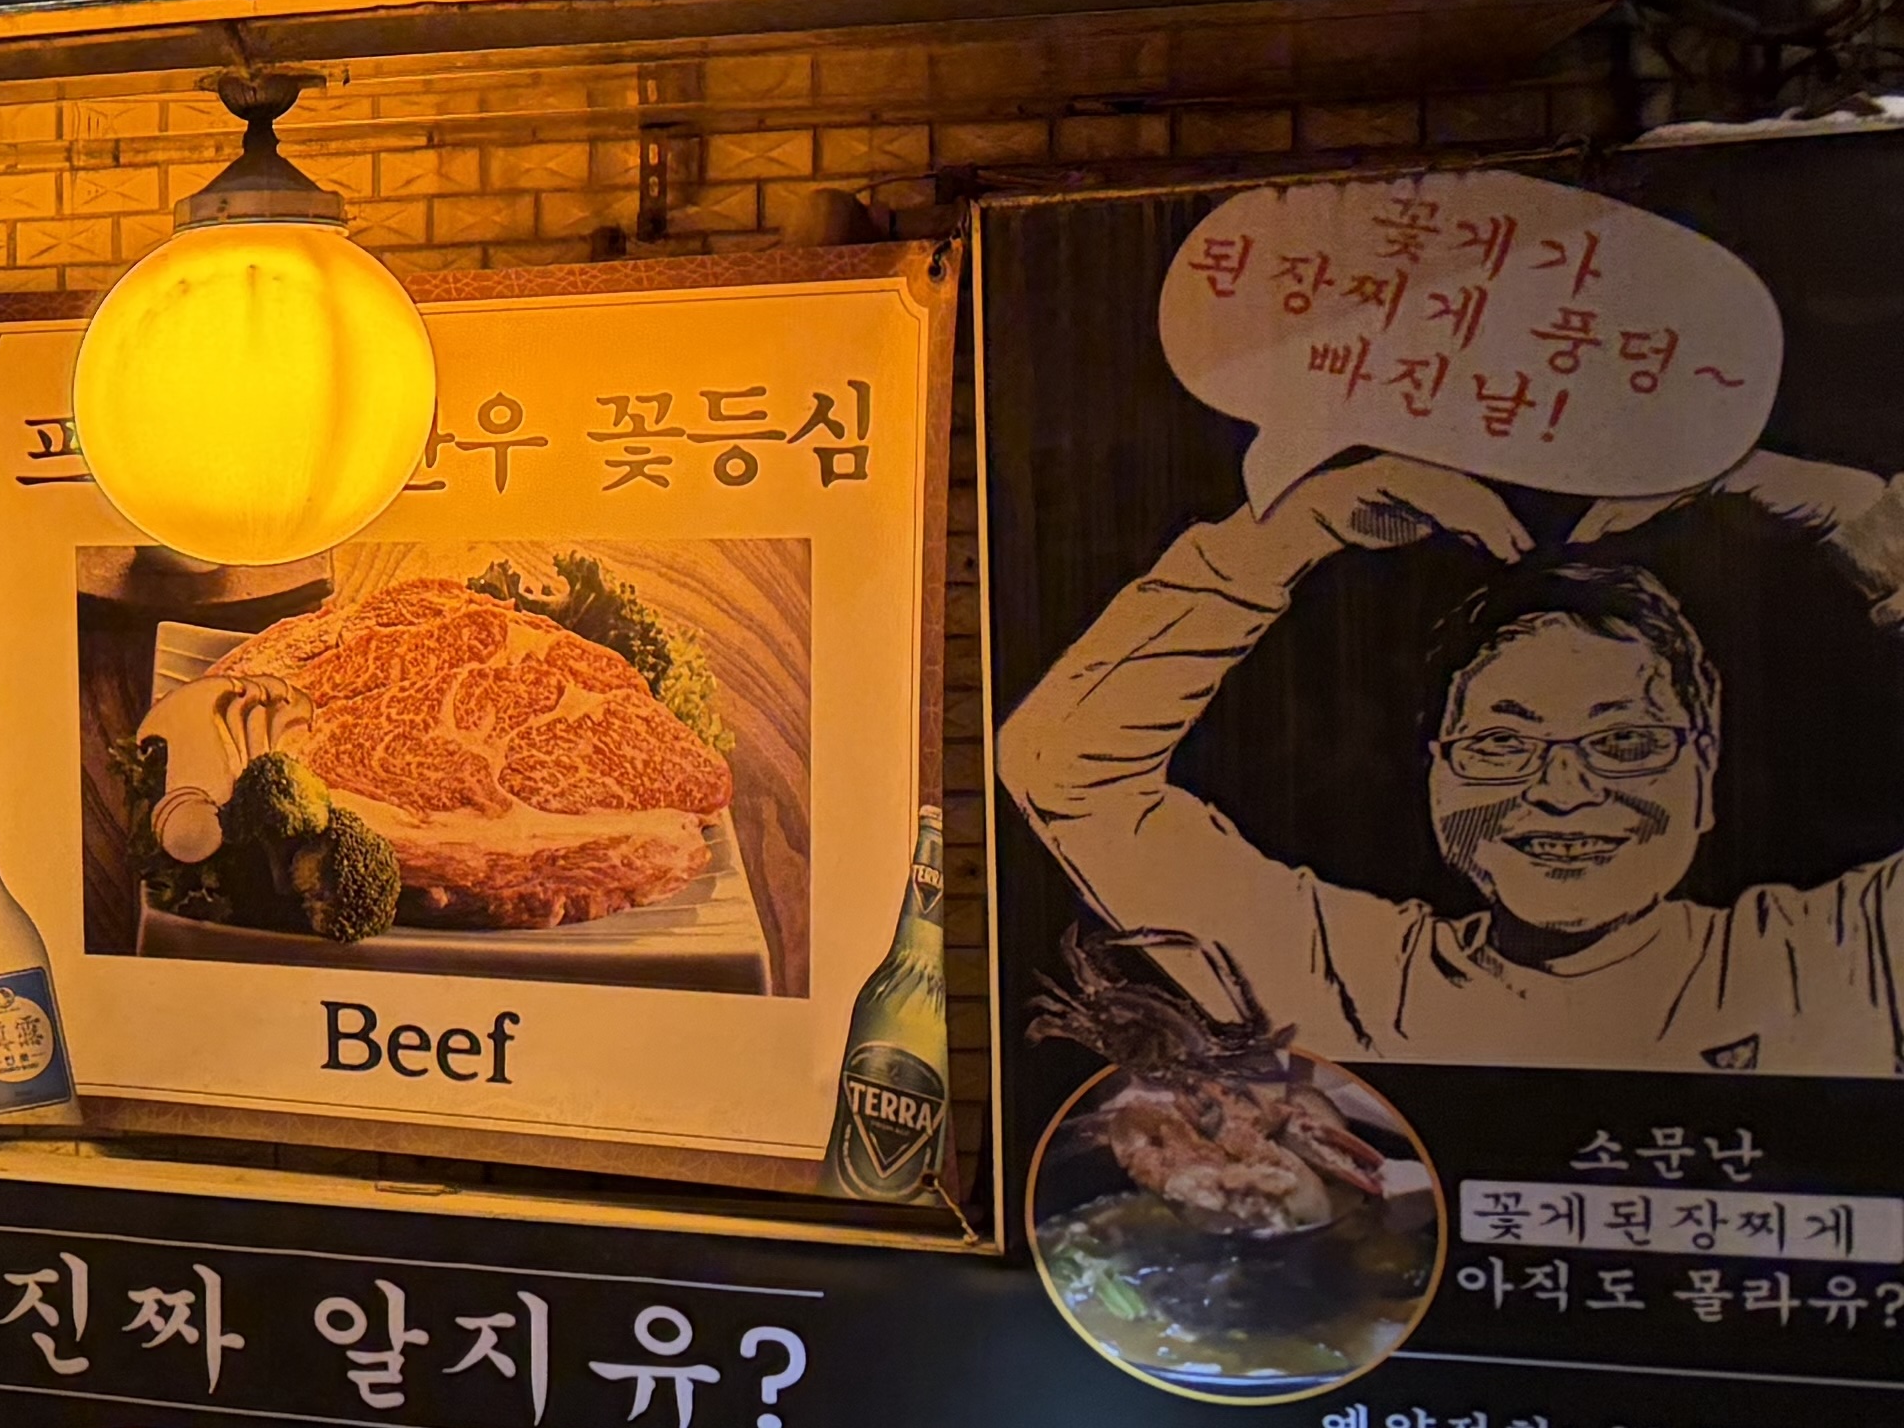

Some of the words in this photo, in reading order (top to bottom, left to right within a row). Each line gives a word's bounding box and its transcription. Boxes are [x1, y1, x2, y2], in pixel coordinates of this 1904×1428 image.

[1372, 197, 1602, 295] 꽃게가
[1191, 235, 1489, 351] 된장찌게
[1530, 307, 1745, 395] 풍덩~
[586, 379, 873, 492] 꽃등심
[319, 999, 520, 1086] Beef
[848, 1080, 934, 1138] TERRA
[1570, 1126, 1763, 1182] 소문난
[1474, 1190, 1856, 1258] 꽃게된장찌게
[1456, 1258, 1646, 1314] 아직도
[1674, 1269, 1904, 1330] 몰라유?
